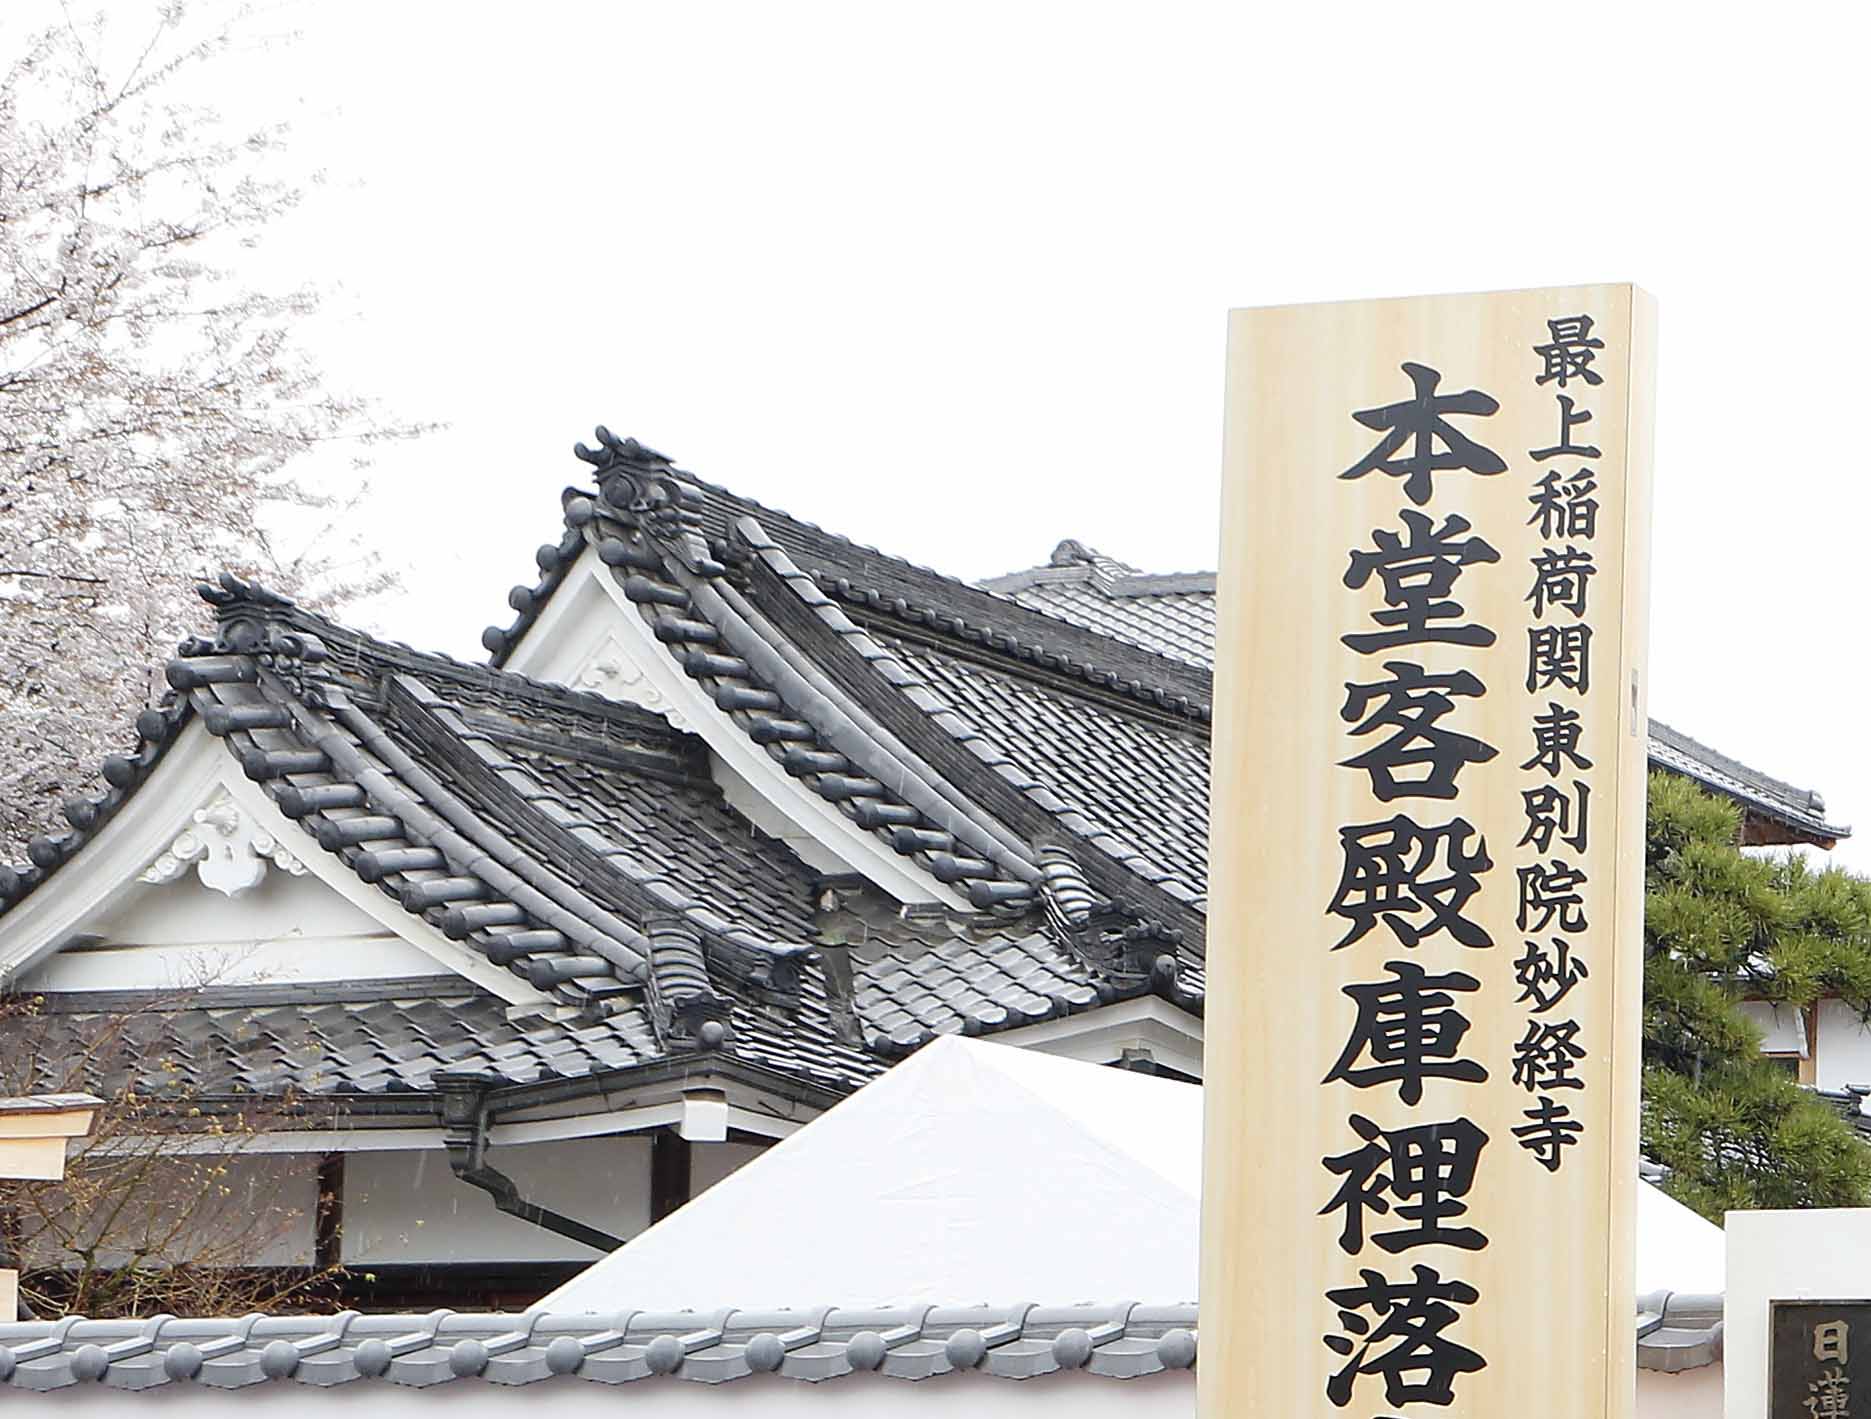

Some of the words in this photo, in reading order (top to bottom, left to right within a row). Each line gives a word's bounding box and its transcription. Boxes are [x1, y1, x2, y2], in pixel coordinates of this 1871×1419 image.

[1511, 314, 1605, 1174] 最上稲荷関東別院妙経寺
